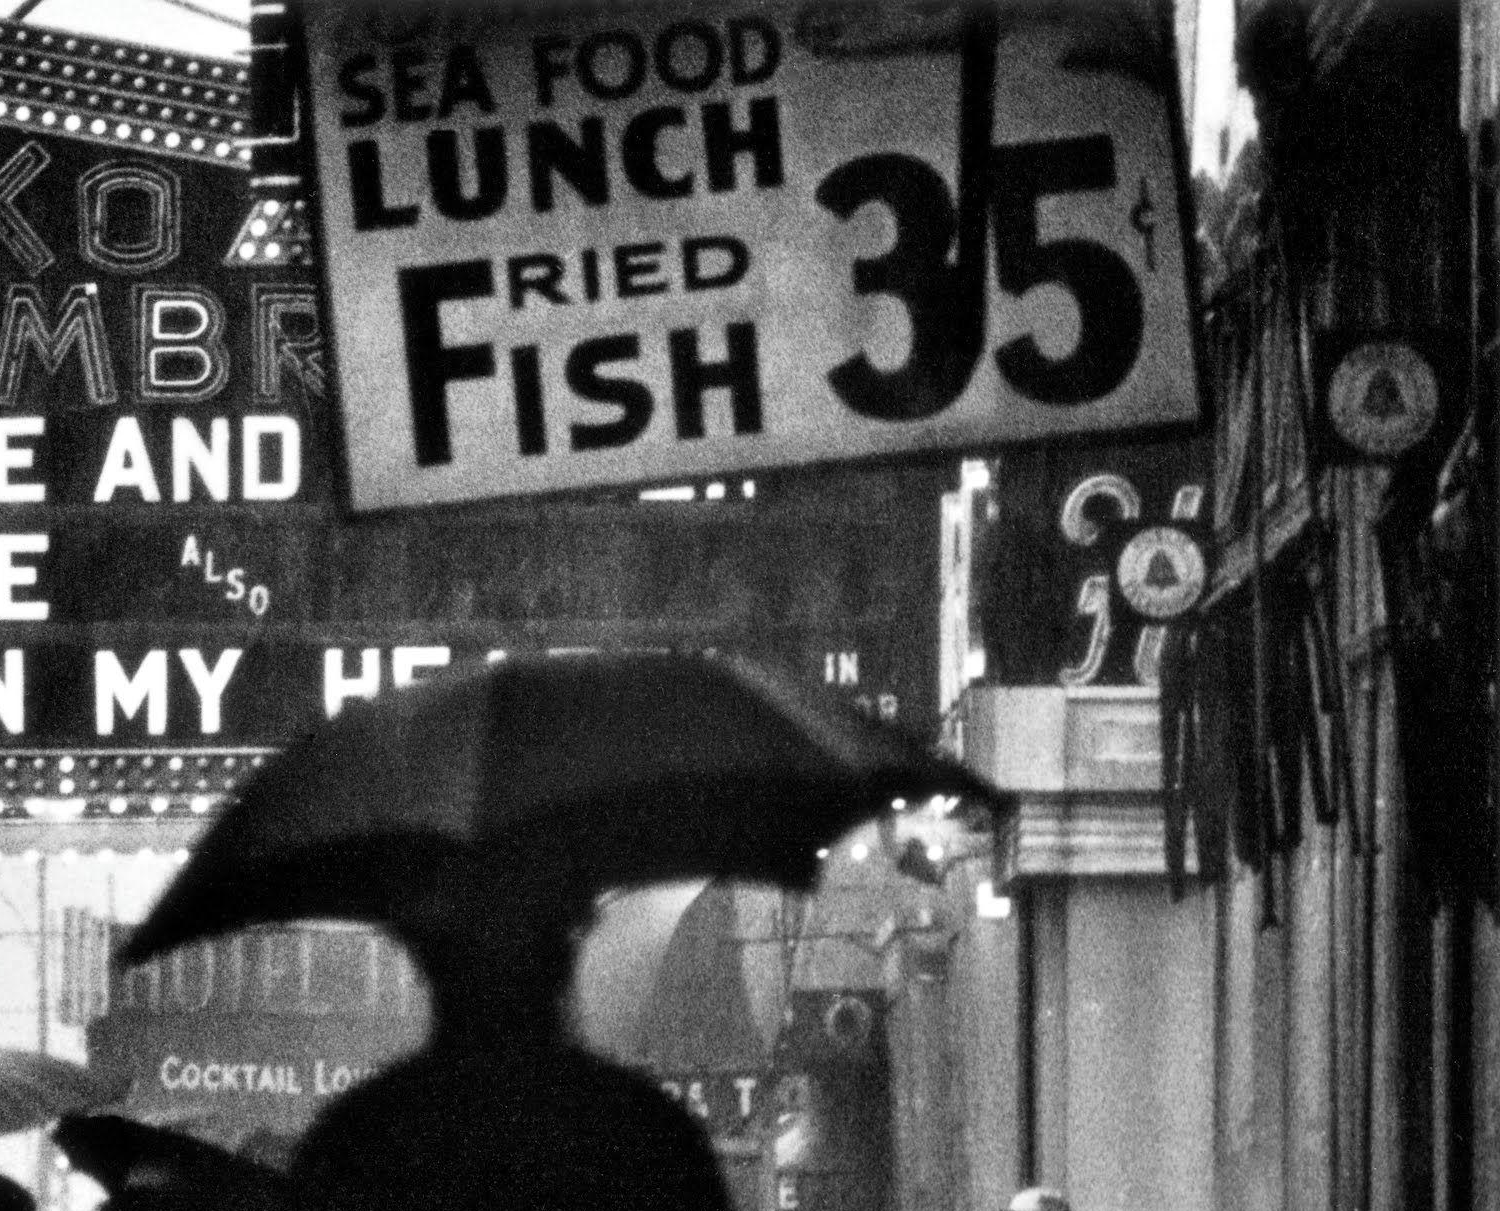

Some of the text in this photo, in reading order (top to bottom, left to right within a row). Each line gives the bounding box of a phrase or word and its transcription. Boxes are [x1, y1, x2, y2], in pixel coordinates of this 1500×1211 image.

[338, 17, 781, 128] SEA FOOD
[347, 97, 784, 232] LUNCH
[397, 258, 764, 467] FISH
[94, 415, 300, 502] AND
[182, 535, 269, 615] ALSO
[94, 648, 243, 736] MY
[824, 652, 858, 685] IN
[160, 1055, 302, 1096] COCKTAIL
